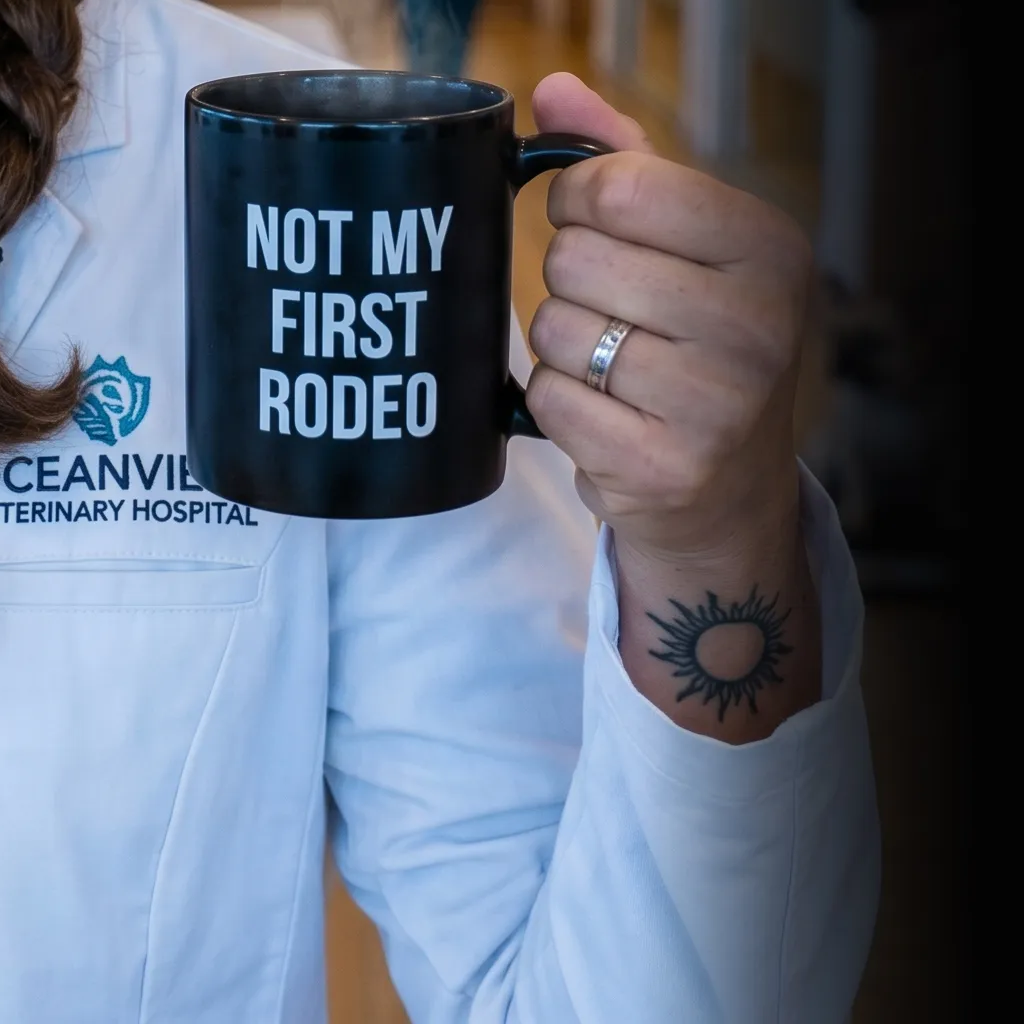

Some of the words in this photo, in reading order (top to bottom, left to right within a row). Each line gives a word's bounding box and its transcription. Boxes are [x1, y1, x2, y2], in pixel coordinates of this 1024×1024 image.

[246, 203, 353, 276] NOT
[371, 205, 454, 276] MY
[271, 288, 428, 359] FIRST
[259, 367, 437, 440] RODEO
[132, 499, 259, 527] HOSPITAL
